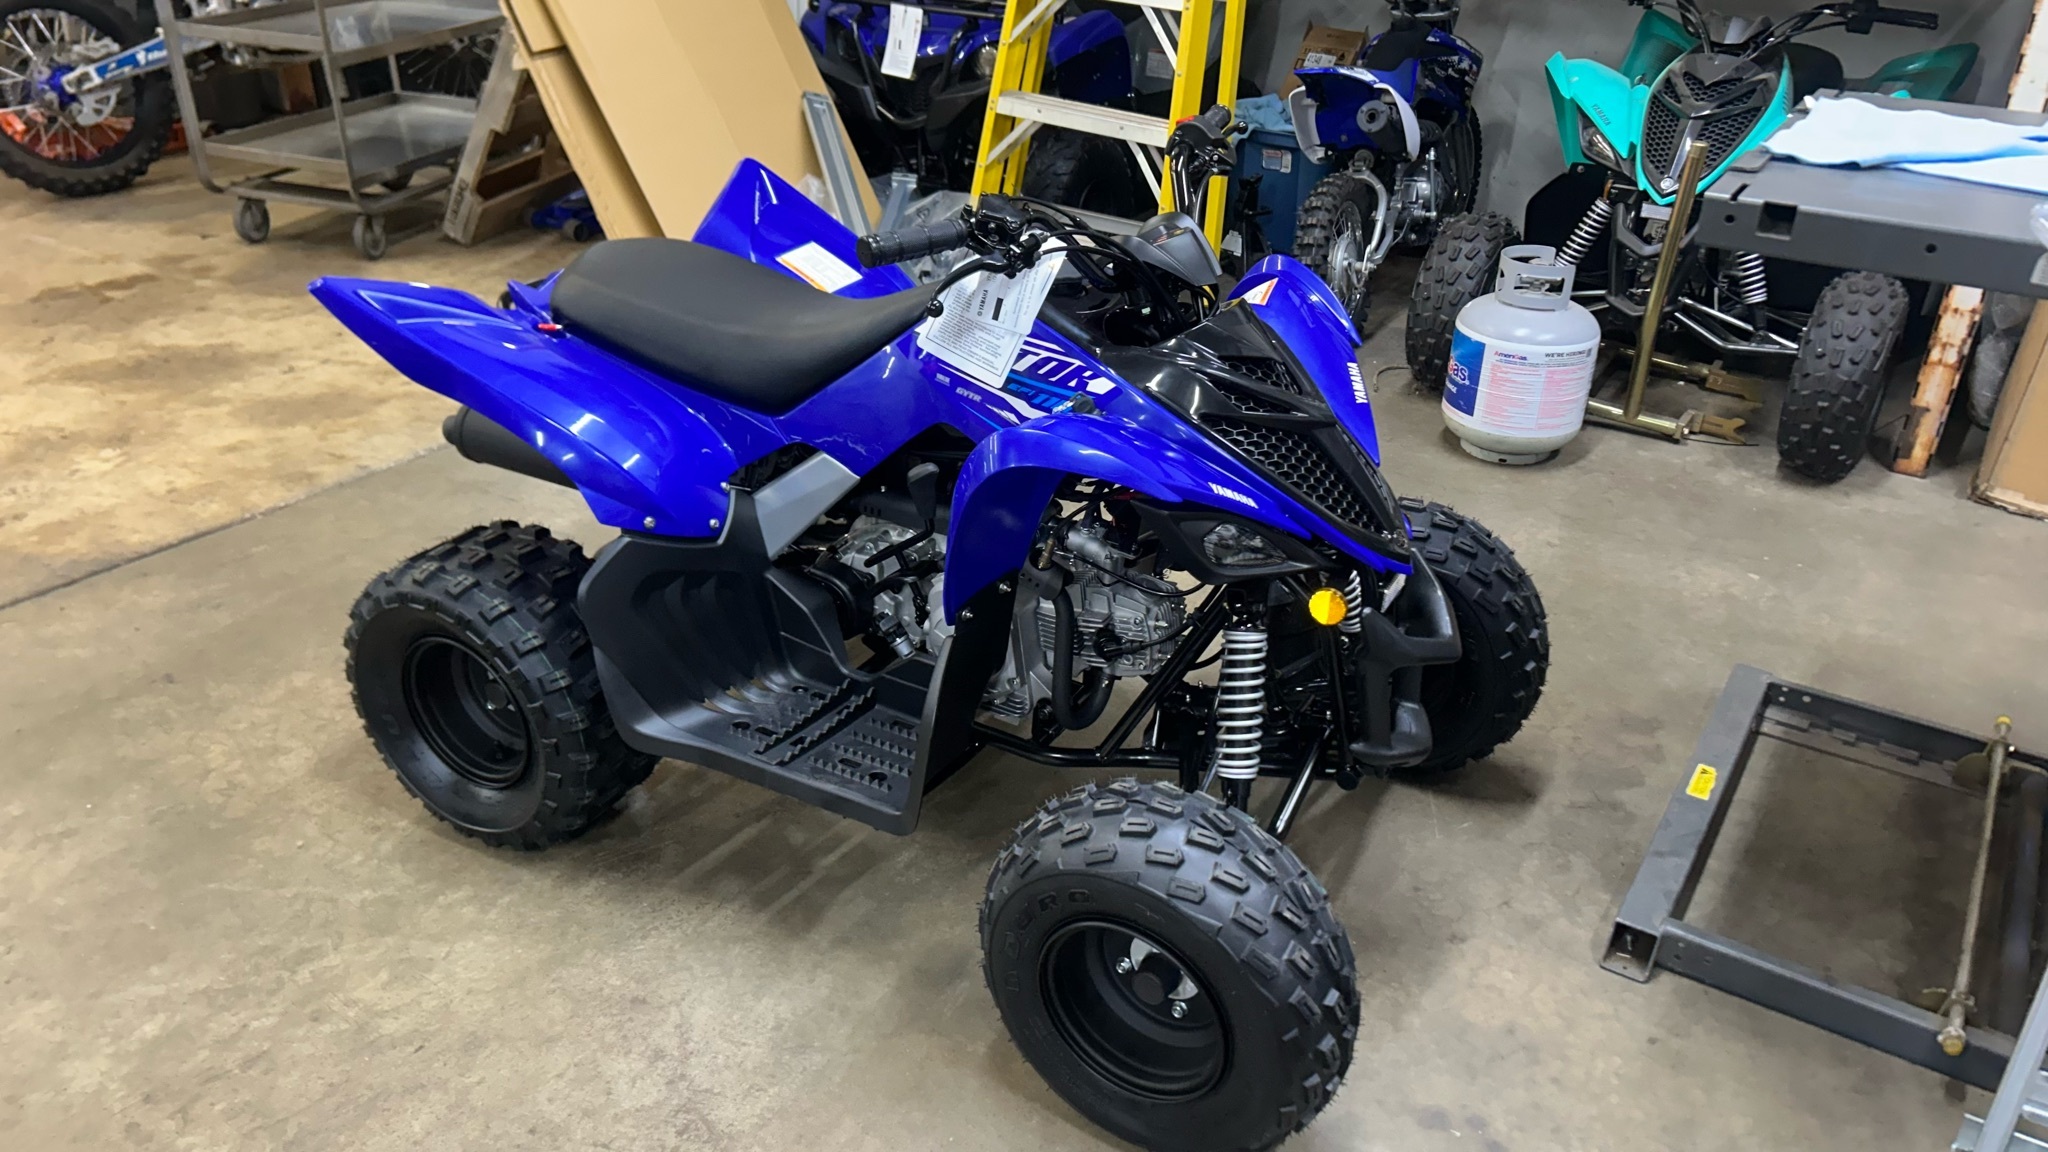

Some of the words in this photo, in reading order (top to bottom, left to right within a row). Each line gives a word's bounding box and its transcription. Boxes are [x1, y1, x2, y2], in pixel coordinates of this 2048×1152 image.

[979, 289, 989, 310] YAMAHA
[1007, 382, 1036, 397] EFI
[1346, 362, 1369, 404] YAMAHA
[955, 387, 982, 403] GYTR
[1207, 481, 1260, 509] YAMAHA
